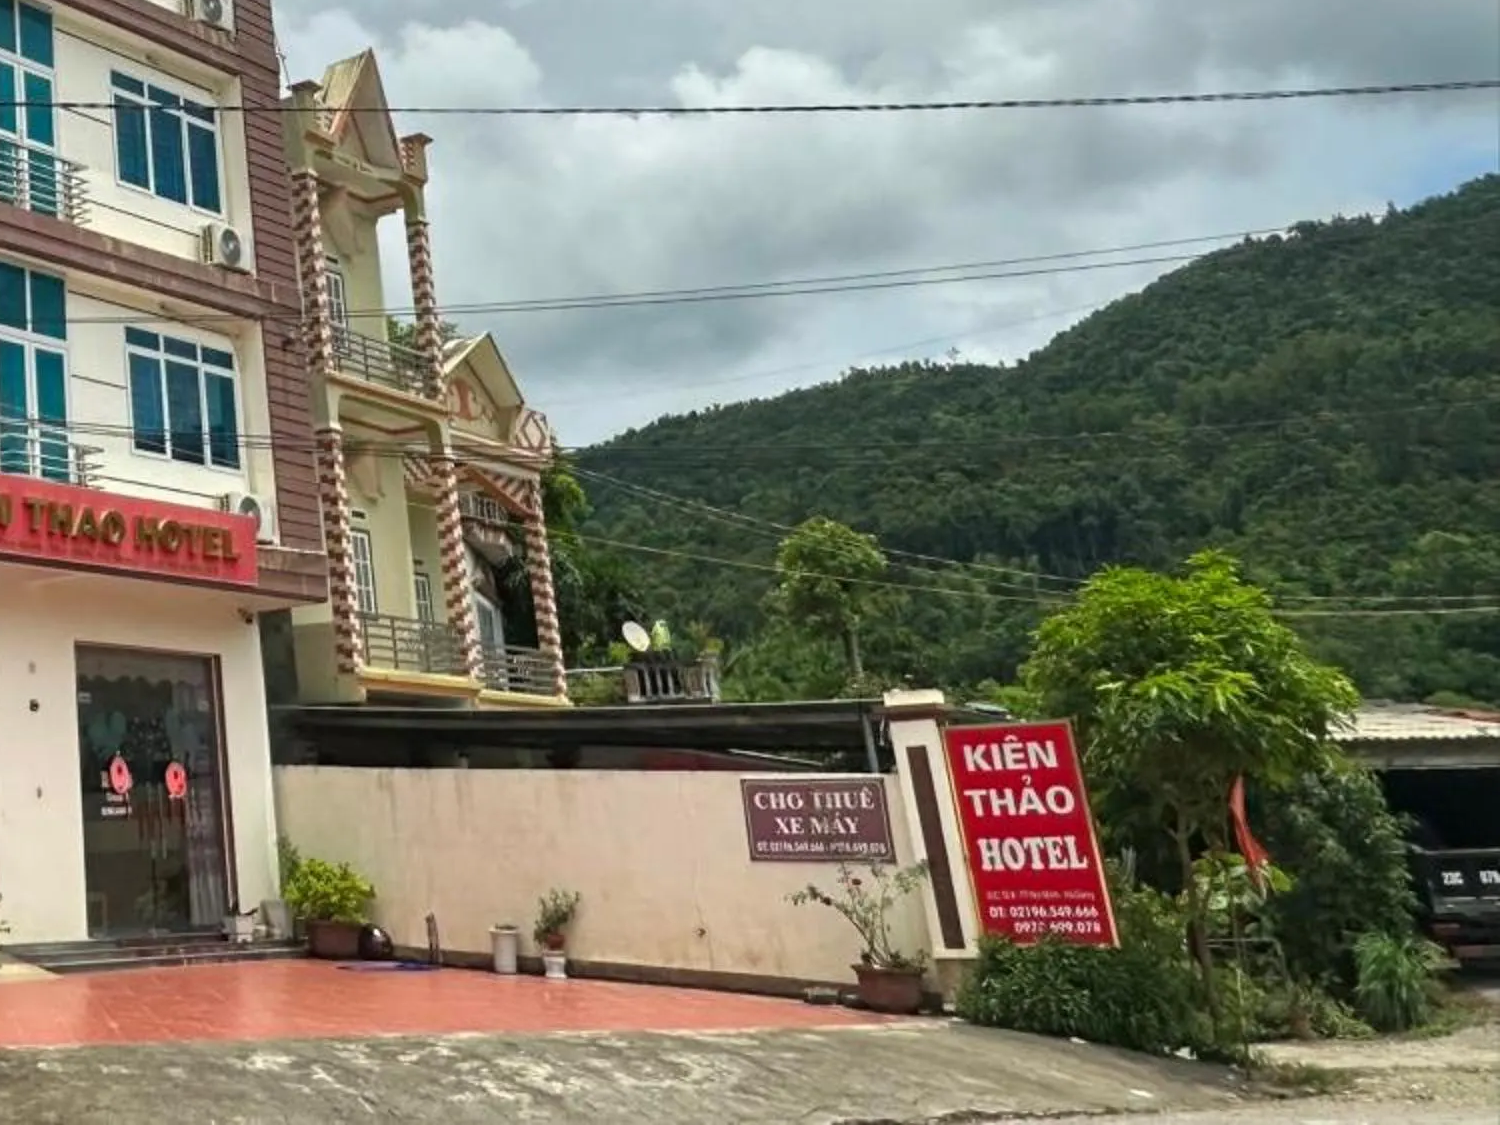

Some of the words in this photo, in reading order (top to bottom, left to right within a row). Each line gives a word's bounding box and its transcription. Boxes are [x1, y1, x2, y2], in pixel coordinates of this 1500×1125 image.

[135, 514, 240, 561] HOTEL
[963, 735, 1058, 772] KIÊN
[754, 792, 804, 809] CHO
[813, 786, 875, 809] THUÊ
[964, 775, 1075, 817] THẢO
[775, 817, 804, 835] XE
[810, 811, 859, 835] MÁY
[977, 835, 1088, 872] HOTEL
